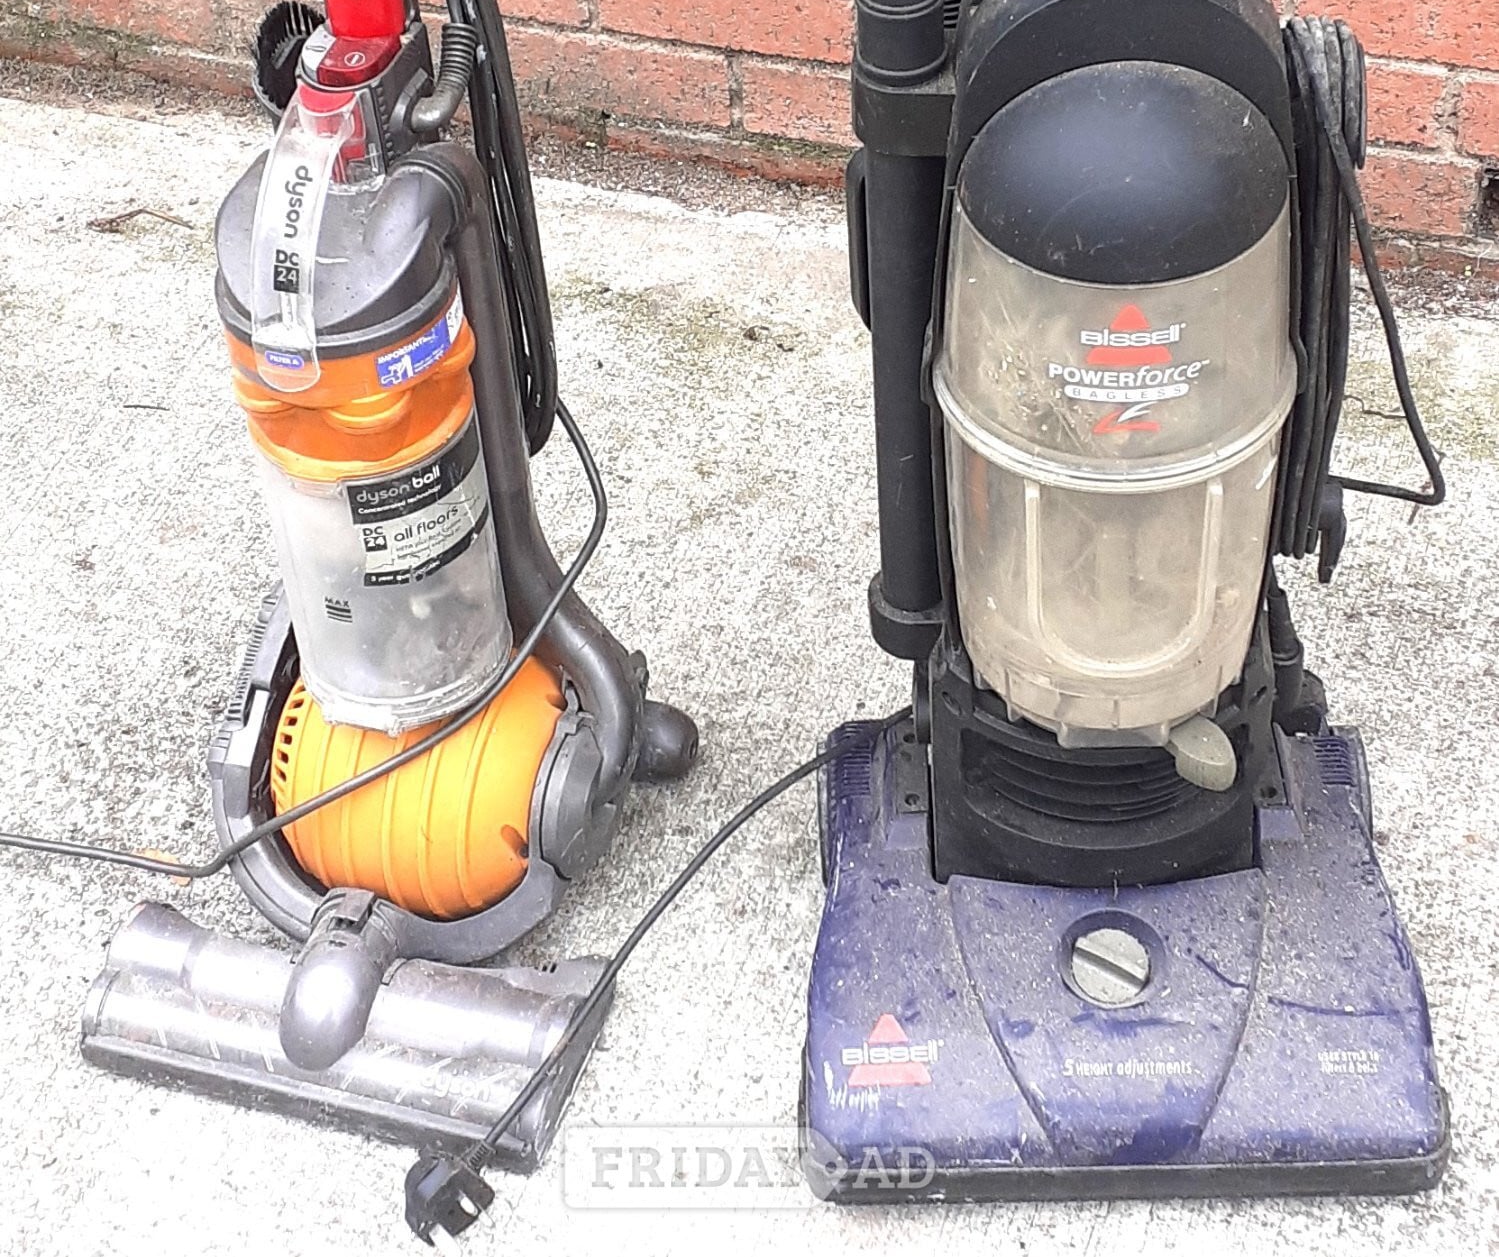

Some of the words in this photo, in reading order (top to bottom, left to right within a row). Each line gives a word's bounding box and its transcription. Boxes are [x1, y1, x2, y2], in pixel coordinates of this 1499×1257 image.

[284, 165, 313, 238] dyson
[275, 249, 299, 266] DC
[276, 267, 298, 284] 24
[1072, 386, 1181, 400] BAGLESS
[356, 484, 410, 504] dyson
[412, 465, 440, 488] ball
[362, 526, 384, 536] DC
[394, 526, 413, 542] all
[417, 506, 458, 535] floors
[365, 536, 386, 547] 24
[325, 596, 349, 607] MAX
[1063, 1059, 1074, 1076] 5
[1076, 1062, 1113, 1076] HEIGHT
[1117, 1058, 1192, 1079] adjustments
